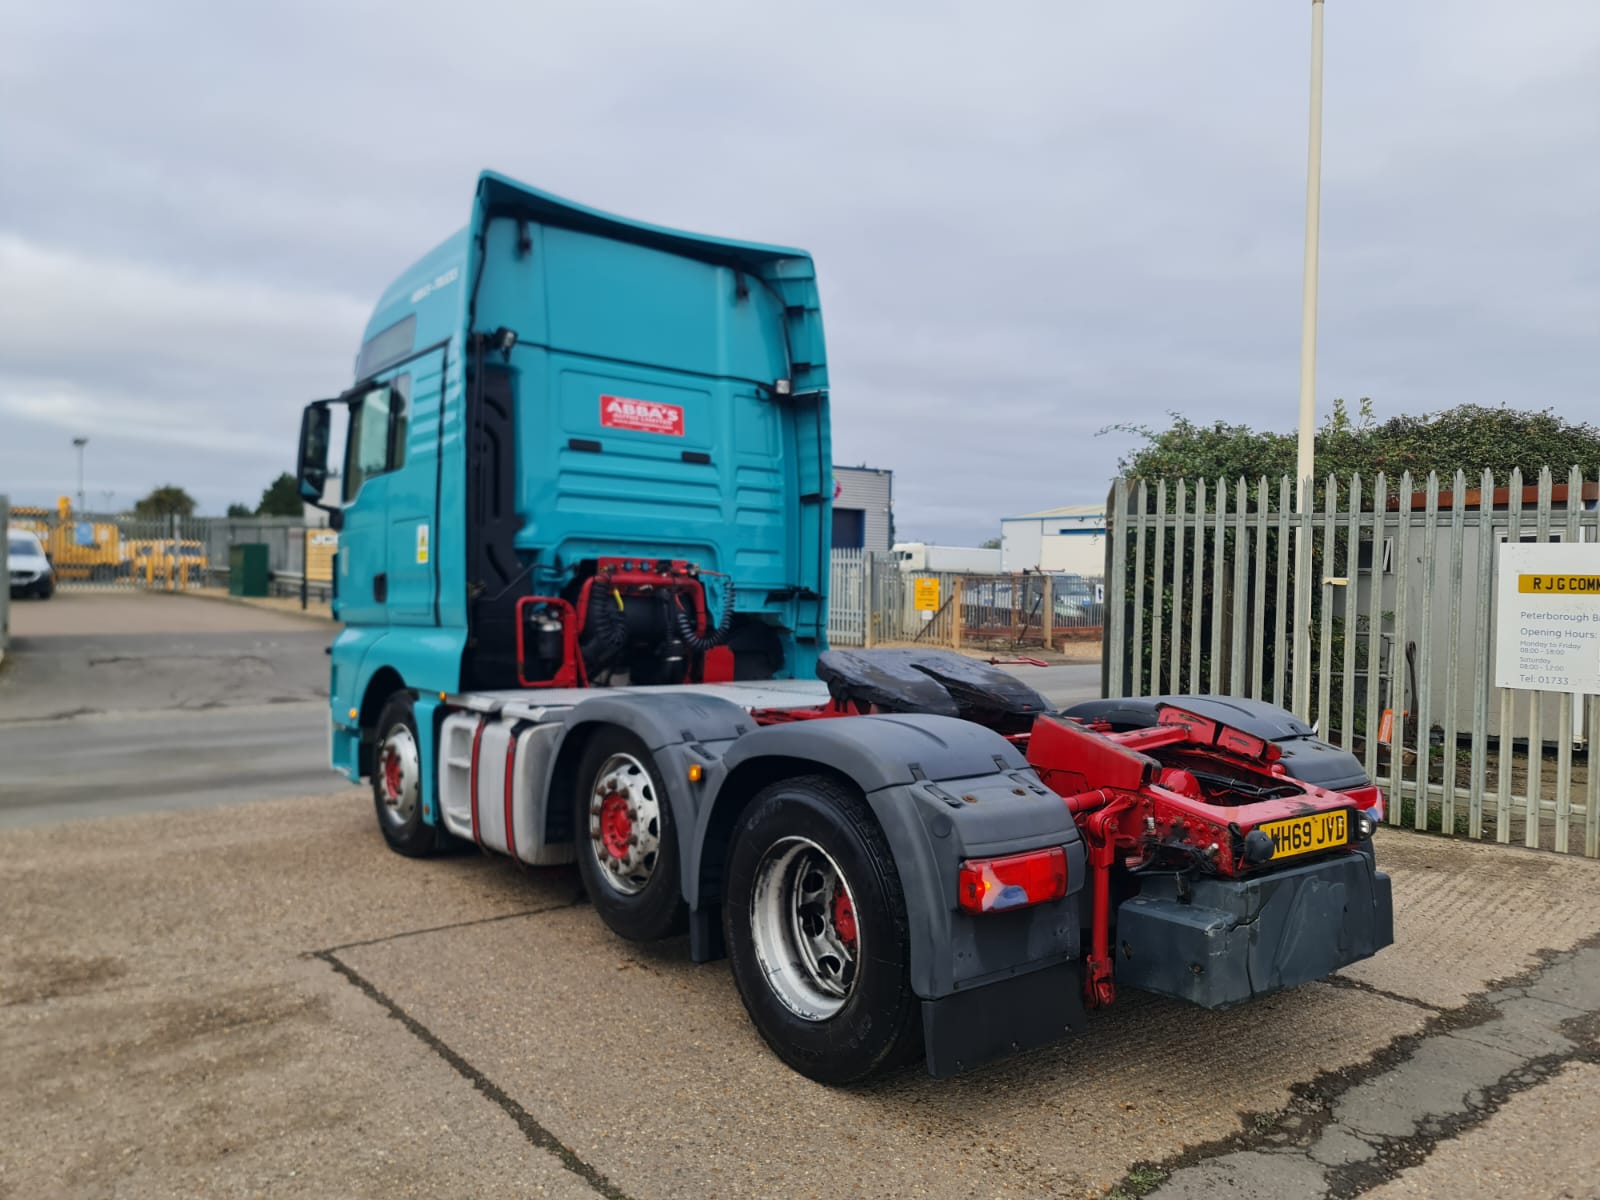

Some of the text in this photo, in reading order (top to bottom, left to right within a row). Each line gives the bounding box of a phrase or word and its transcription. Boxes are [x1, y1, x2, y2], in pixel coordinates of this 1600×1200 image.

[1533, 577, 1541, 590] R
[1545, 577, 1553, 590] J
[1557, 577, 1565, 590] G
[1520, 611, 1600, 623] Peterborough B
[1520, 627, 1597, 639] Opening Hours:
[1520, 640, 1548, 649] Monday
[1559, 641, 1581, 651] Friday
[1520, 656, 1551, 664] Saturday
[1538, 675, 1569, 685] 01733
[1270, 821, 1312, 853] WH69
